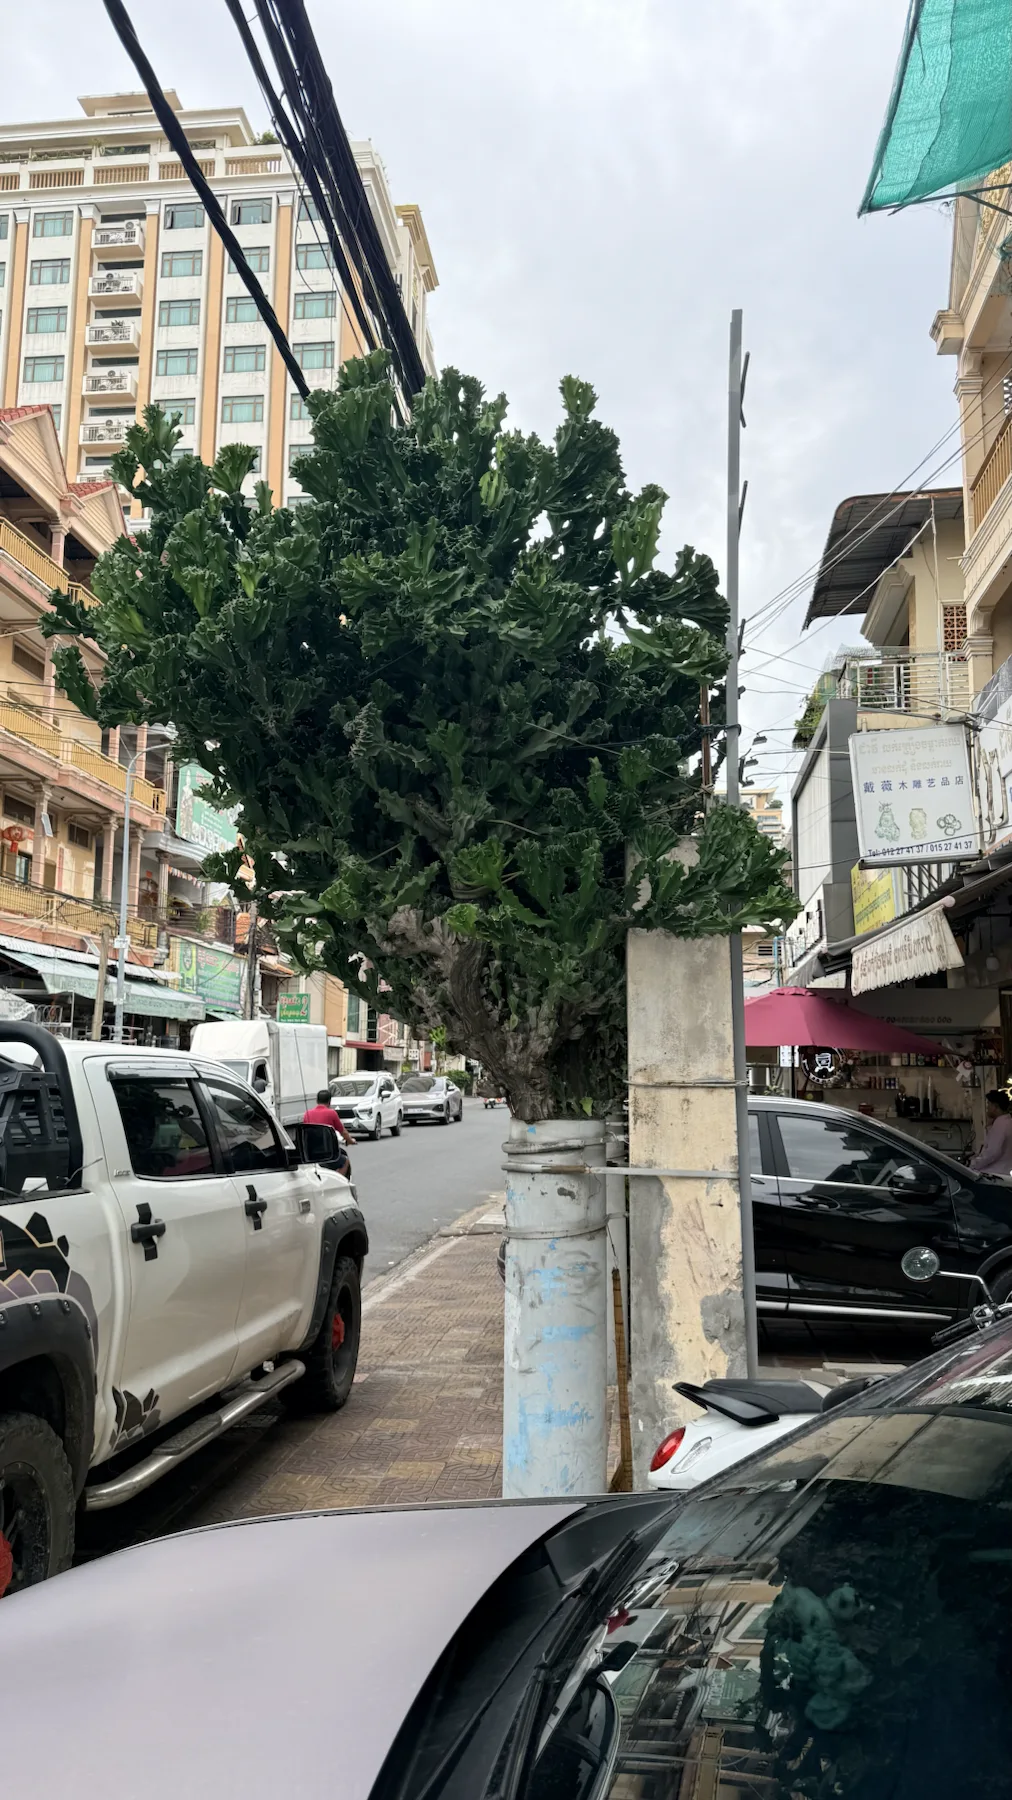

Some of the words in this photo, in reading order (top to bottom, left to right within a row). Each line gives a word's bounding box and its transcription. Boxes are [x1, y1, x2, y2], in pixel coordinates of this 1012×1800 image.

[896, 847, 904, 855] 27
[906, 846, 914, 854] 41
[916, 845, 924, 853] 37
[930, 843, 943, 852] 015
[944, 842, 952, 851] 27
[954, 842, 962, 850] 41
[964, 841, 973, 849] 37
